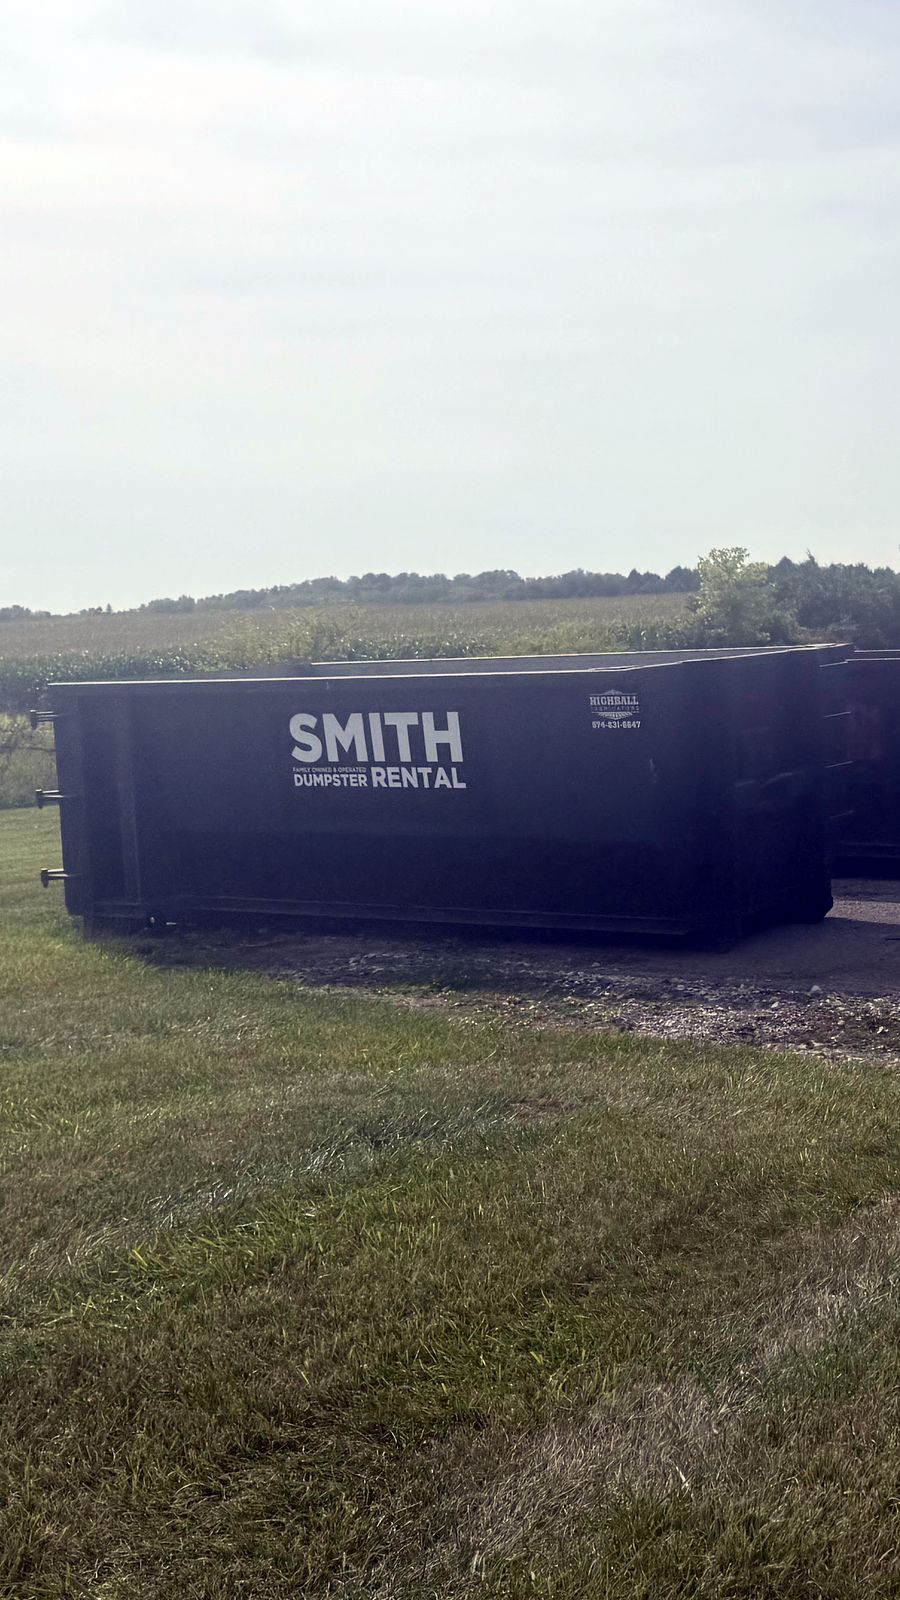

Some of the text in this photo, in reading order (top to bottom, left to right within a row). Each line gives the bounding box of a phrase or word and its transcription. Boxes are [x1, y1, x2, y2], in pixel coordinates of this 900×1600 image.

[589, 696, 639, 705] HIGHBALL
[289, 712, 464, 763] SMITH
[294, 767, 467, 789] DUMPSTER RENTAL
